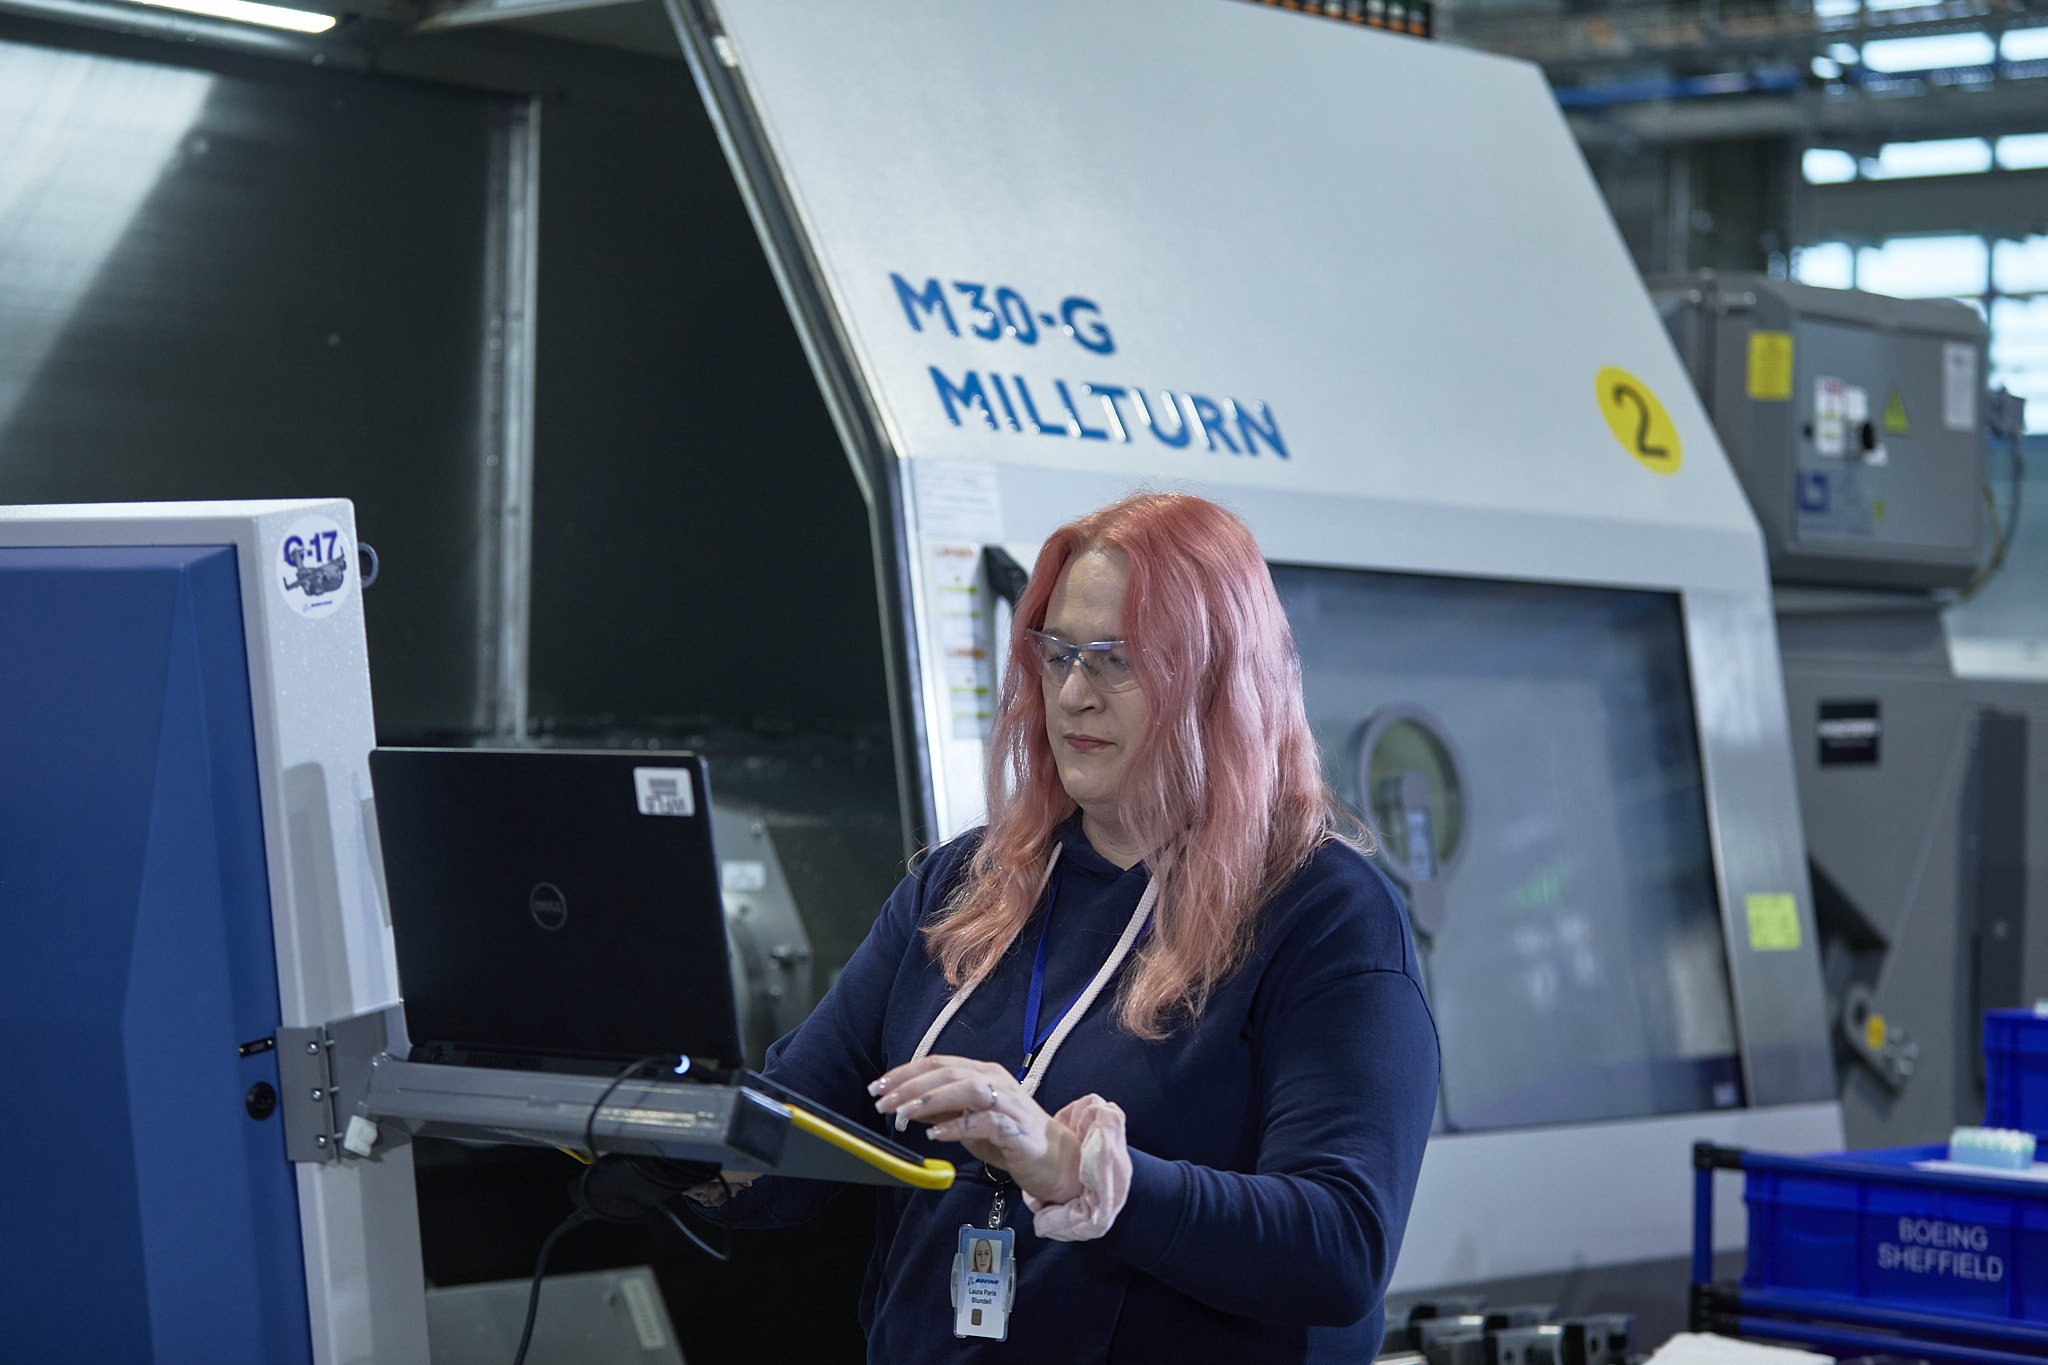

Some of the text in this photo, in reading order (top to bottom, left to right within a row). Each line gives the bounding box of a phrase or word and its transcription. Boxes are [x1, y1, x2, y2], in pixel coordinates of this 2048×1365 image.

[890, 272, 1117, 355] M30-G
[927, 365, 1291, 460] MILLTURN
[1611, 380, 1669, 460] 2
[1898, 1216, 1989, 1252] BOEING
[1878, 1241, 2004, 1283] SHEFFIELD
[968, 1287, 983, 1295] Laura
[971, 1296, 993, 1305] Blundell
